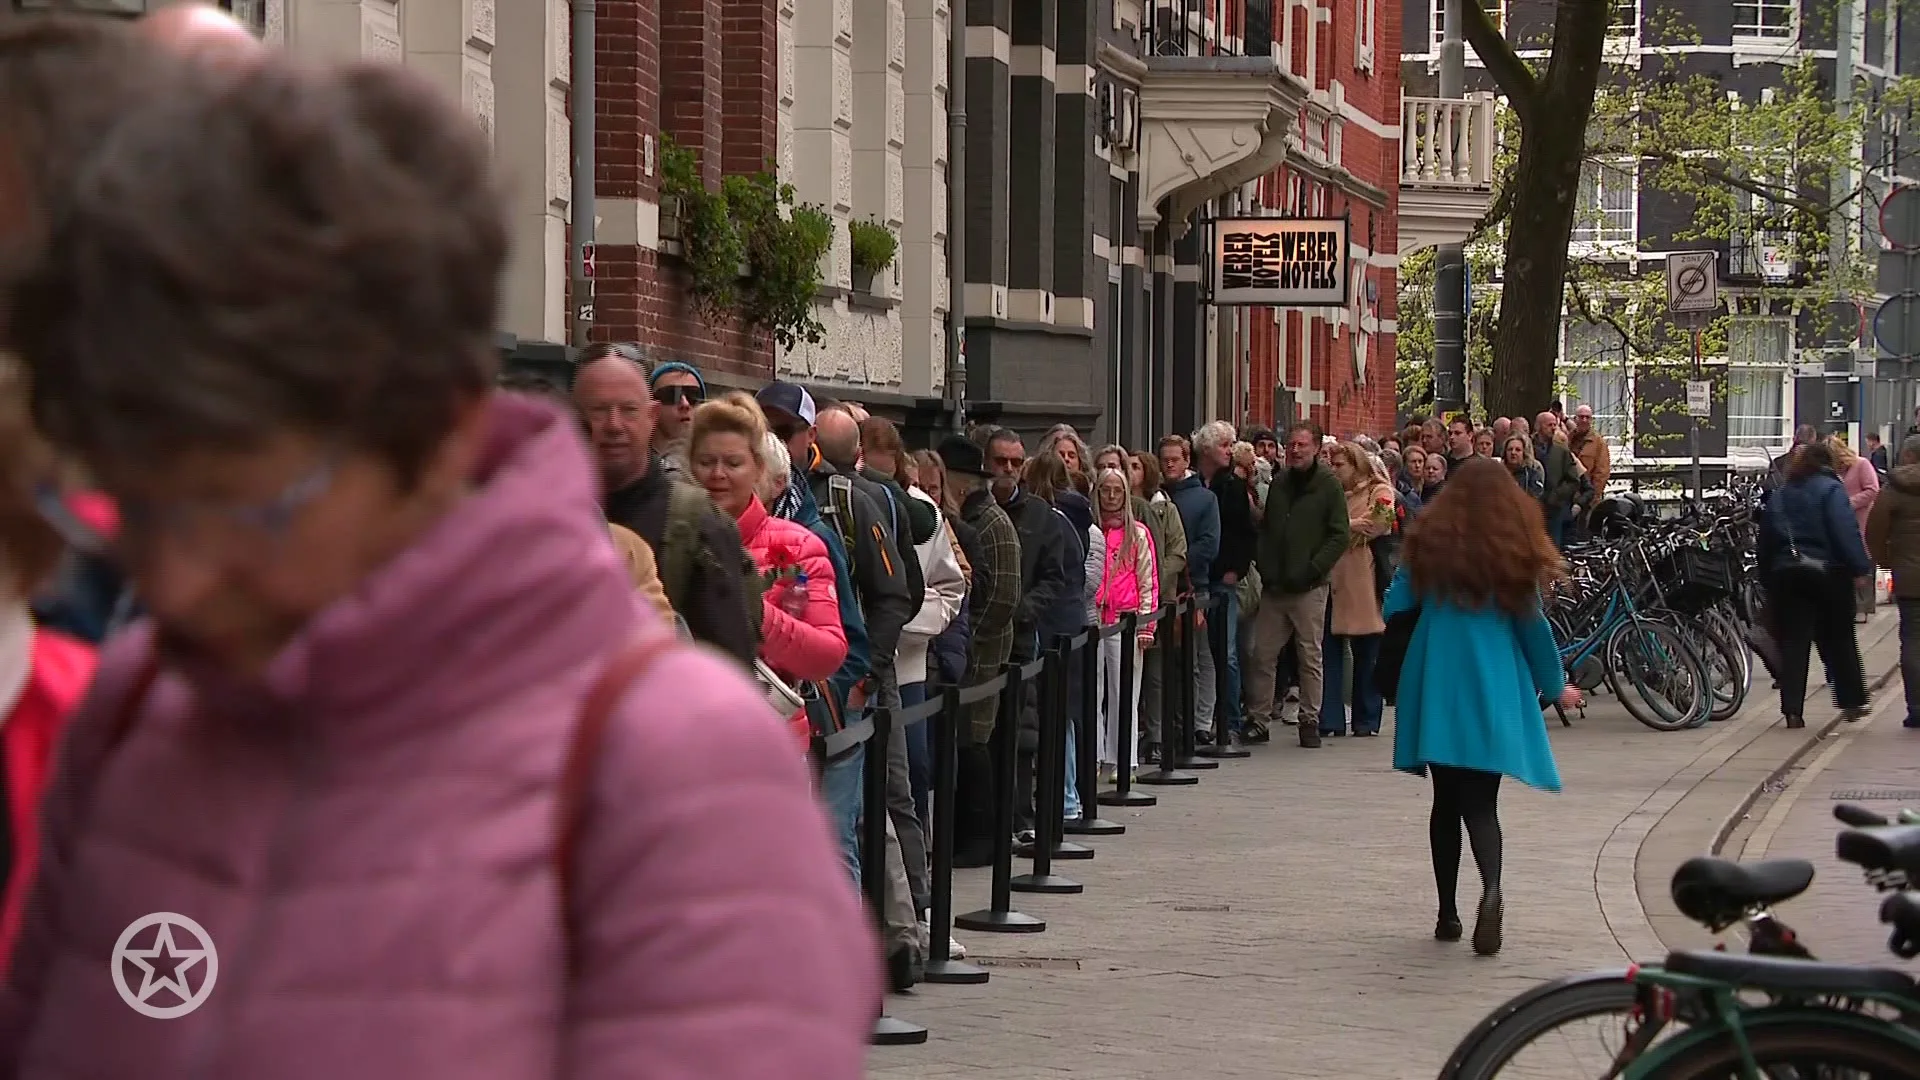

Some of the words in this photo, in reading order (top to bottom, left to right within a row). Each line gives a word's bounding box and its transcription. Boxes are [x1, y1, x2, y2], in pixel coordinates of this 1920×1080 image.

[1223, 232, 1253, 289] WEBER
[1252, 232, 1280, 288] HOTELS
[1280, 231, 1338, 262] WEBER
[1280, 261, 1337, 289] HOTELS
